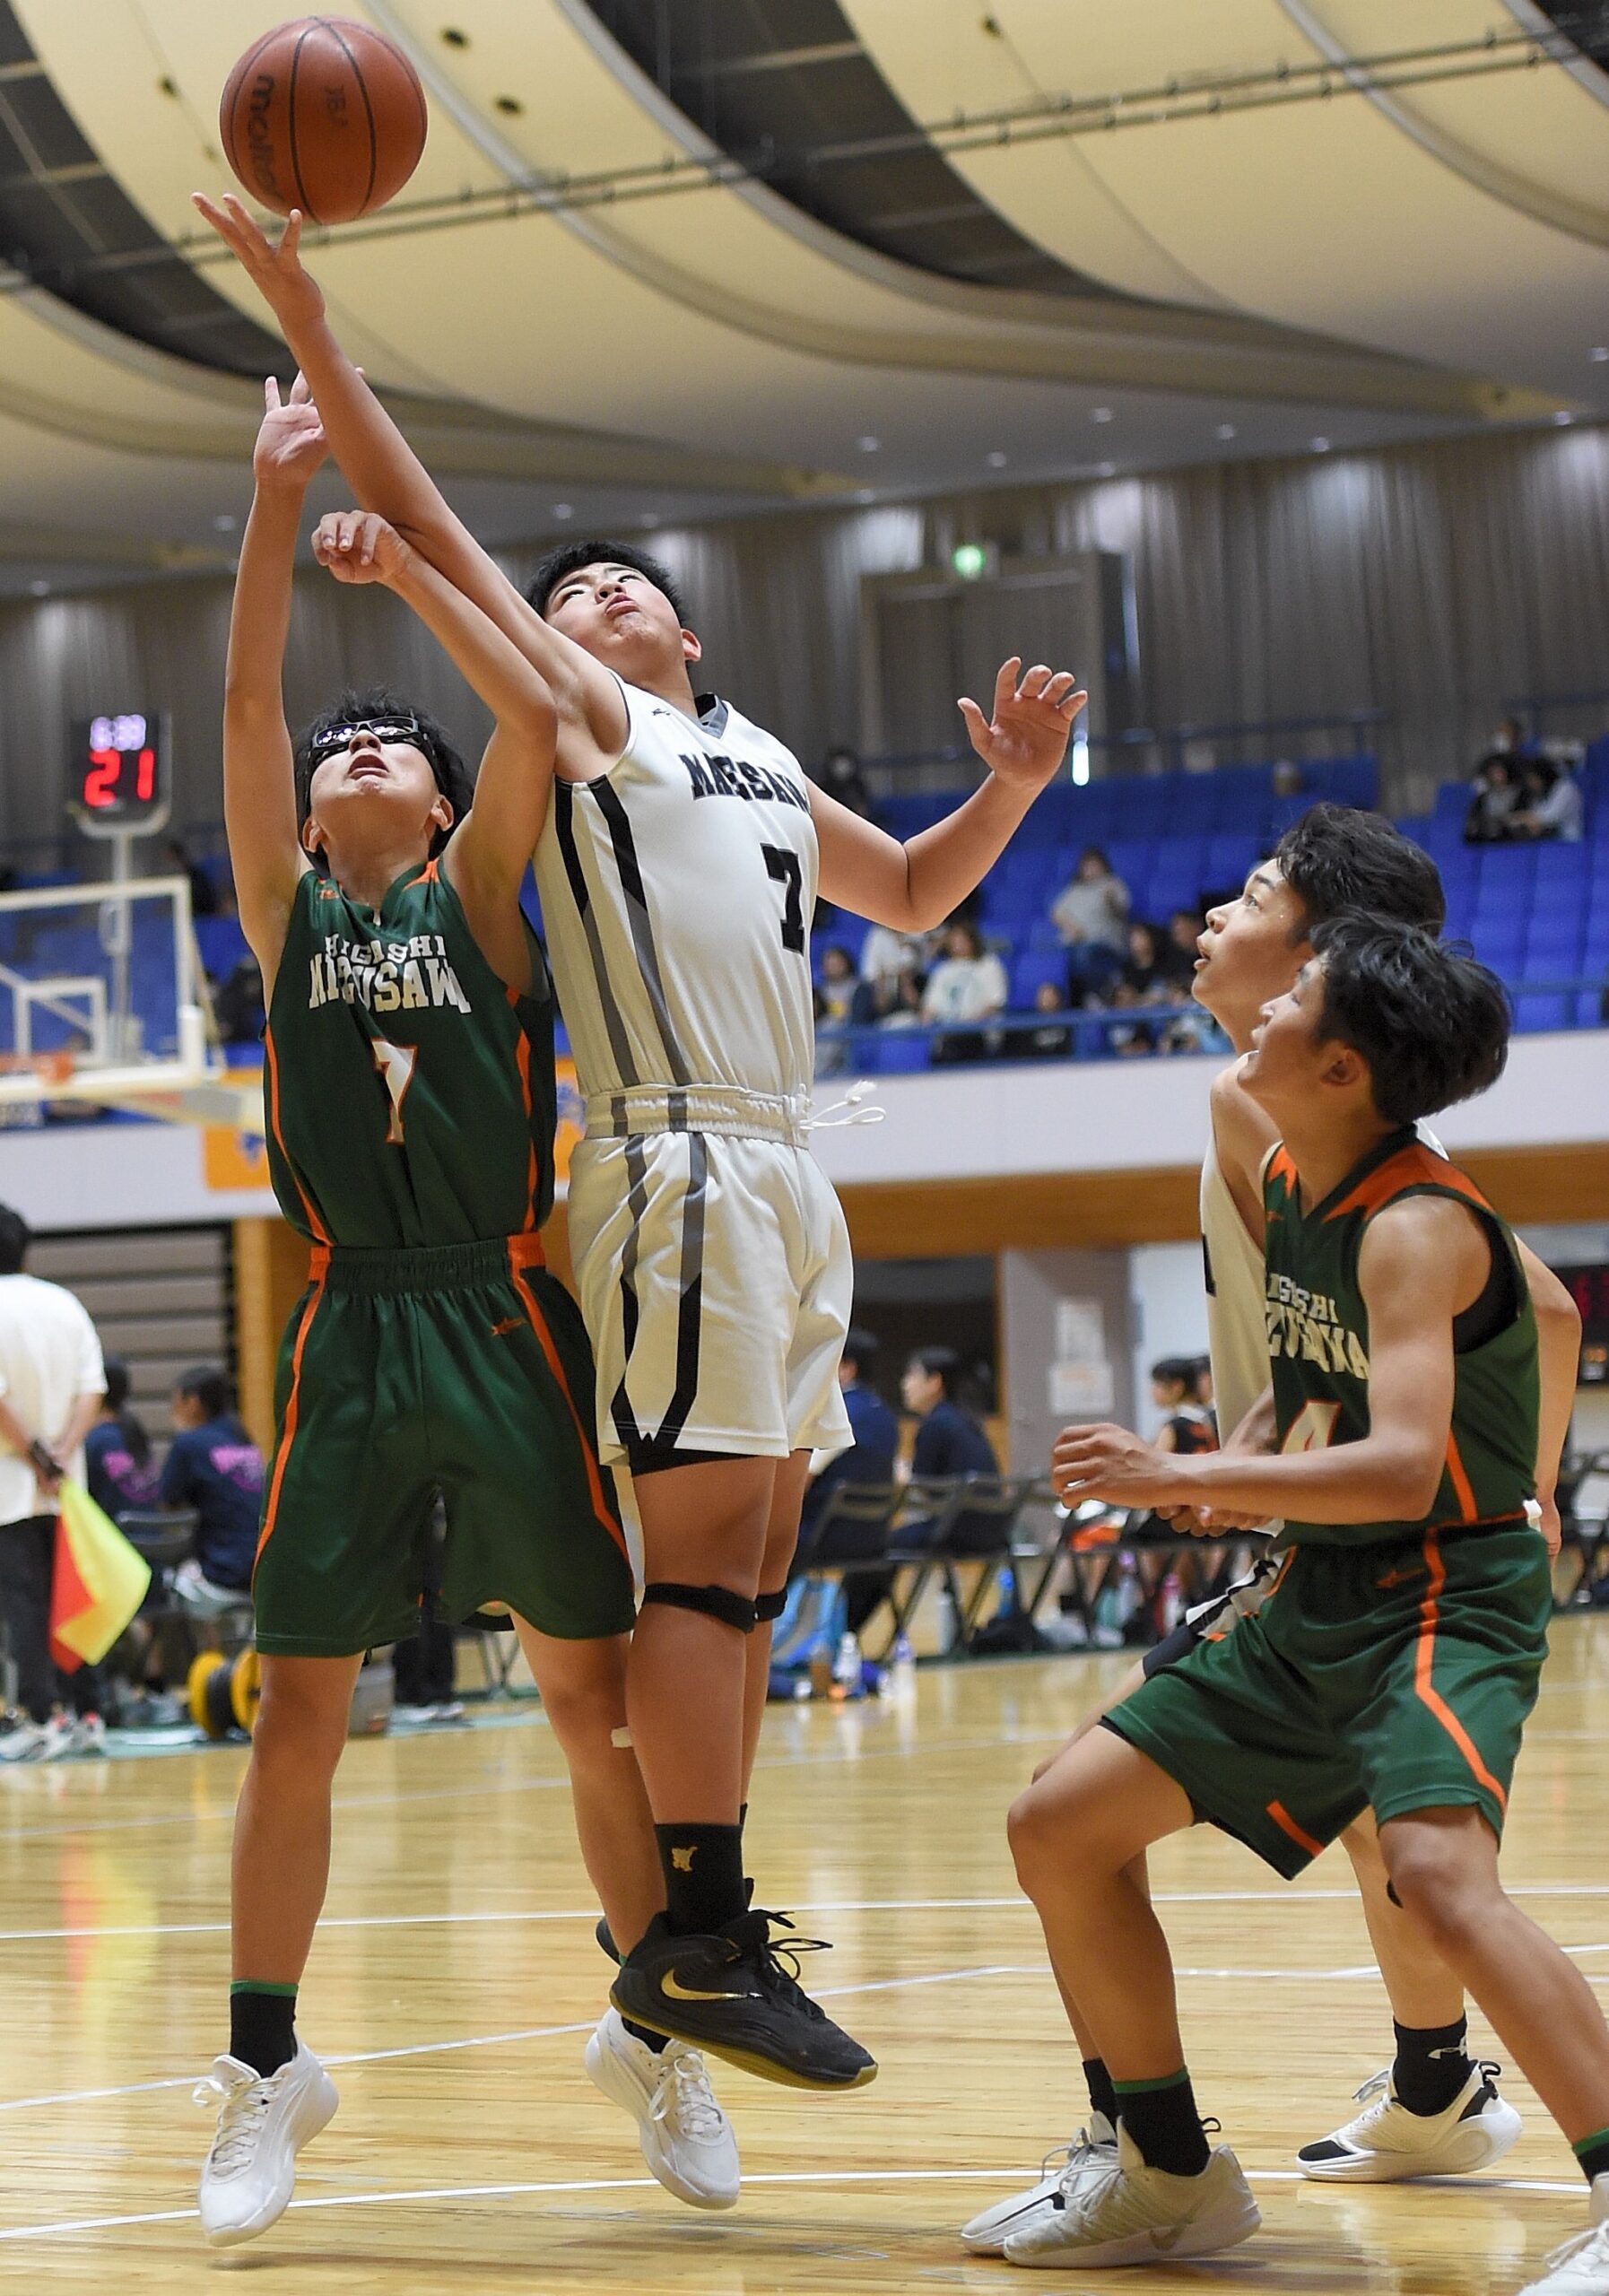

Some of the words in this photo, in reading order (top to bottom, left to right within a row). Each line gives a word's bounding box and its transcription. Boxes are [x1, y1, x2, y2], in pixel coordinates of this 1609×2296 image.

[84, 748, 154, 806] 21
[678, 752, 810, 813] MAESAW
[760, 842, 804, 957] 7
[325, 934, 446, 964] HIGASHI
[371, 1038, 418, 1144] 7
